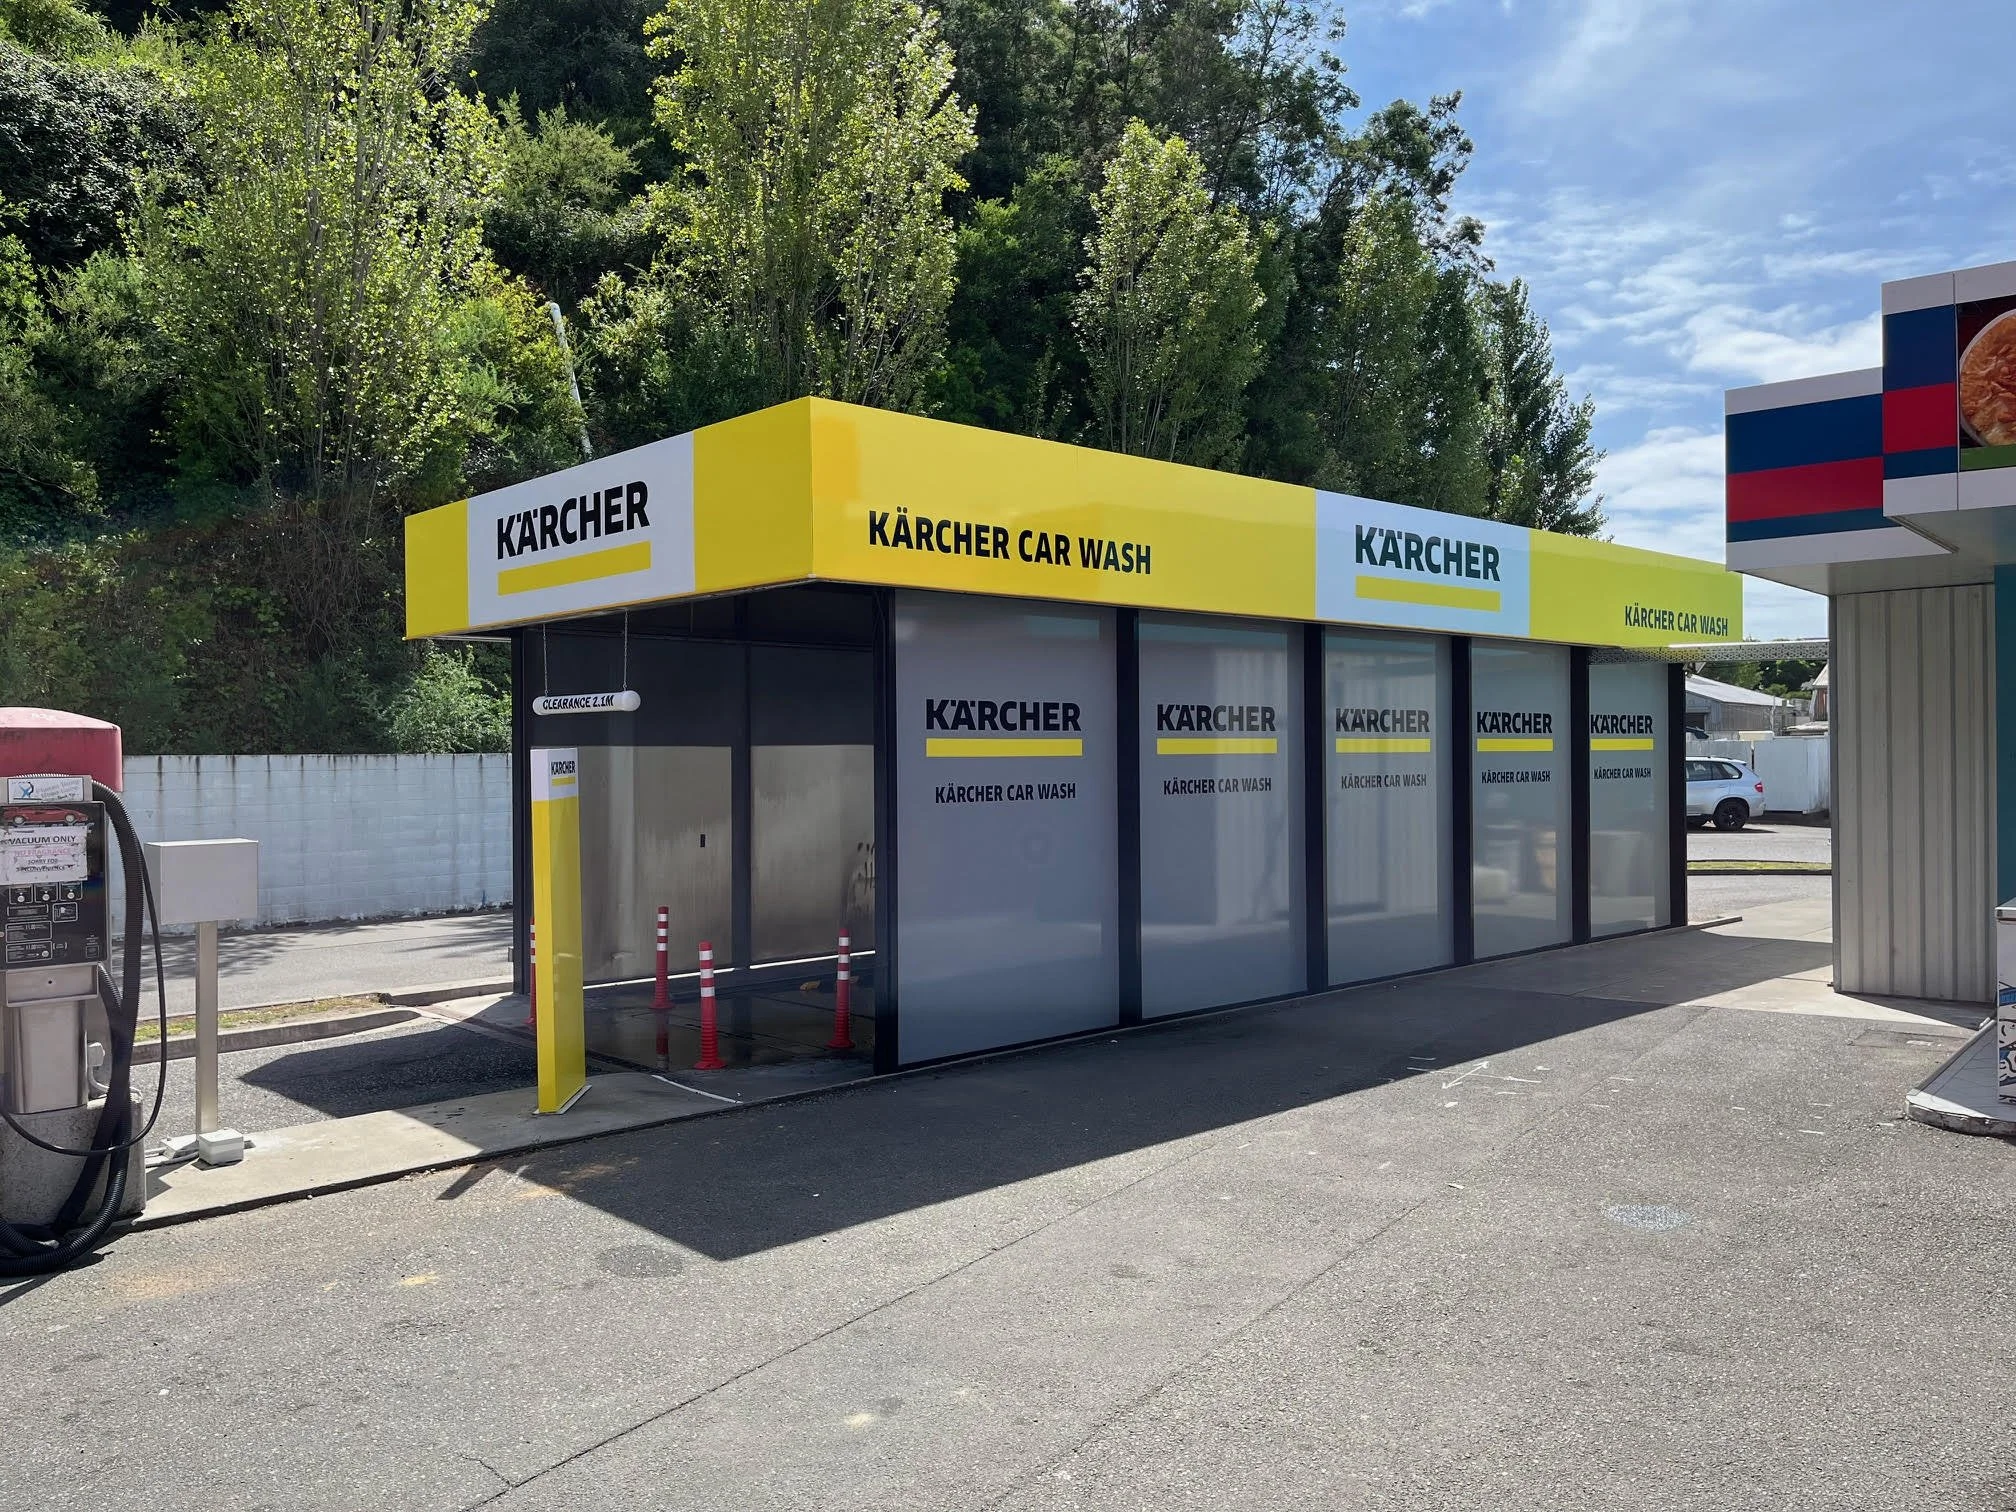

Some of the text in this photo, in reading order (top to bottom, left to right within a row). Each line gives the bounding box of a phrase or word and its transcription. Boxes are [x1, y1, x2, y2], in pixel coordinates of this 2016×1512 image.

[497, 481, 650, 560] KÄRCHER
[869, 506, 1151, 575] KÄRCHER CAR WASH
[1355, 525, 1500, 581] KÄRCHER
[1625, 602, 1728, 636] KÄRCHER CAR WASH
[543, 694, 614, 710] CLEARANCE 2.1M
[926, 699, 1082, 731] KÄRCHER
[1157, 704, 1276, 731] KÄRCHER
[1335, 708, 1430, 732] KÄRCHER
[1477, 711, 1553, 734] KÄRCHER
[1590, 714, 1653, 734] KÄRCHER
[1341, 773, 1427, 789] KÄRCHER CAR WASH
[1481, 769, 1551, 784] KÄRCHER CAR WASH
[1594, 766, 1652, 780] KÄRCHER CAR WASH
[935, 782, 1076, 803] KÄRCHER CAR WASH
[1164, 777, 1272, 795] KÄRCHER CAR WASH
[10, 835, 76, 845] VACUUM ONLY
